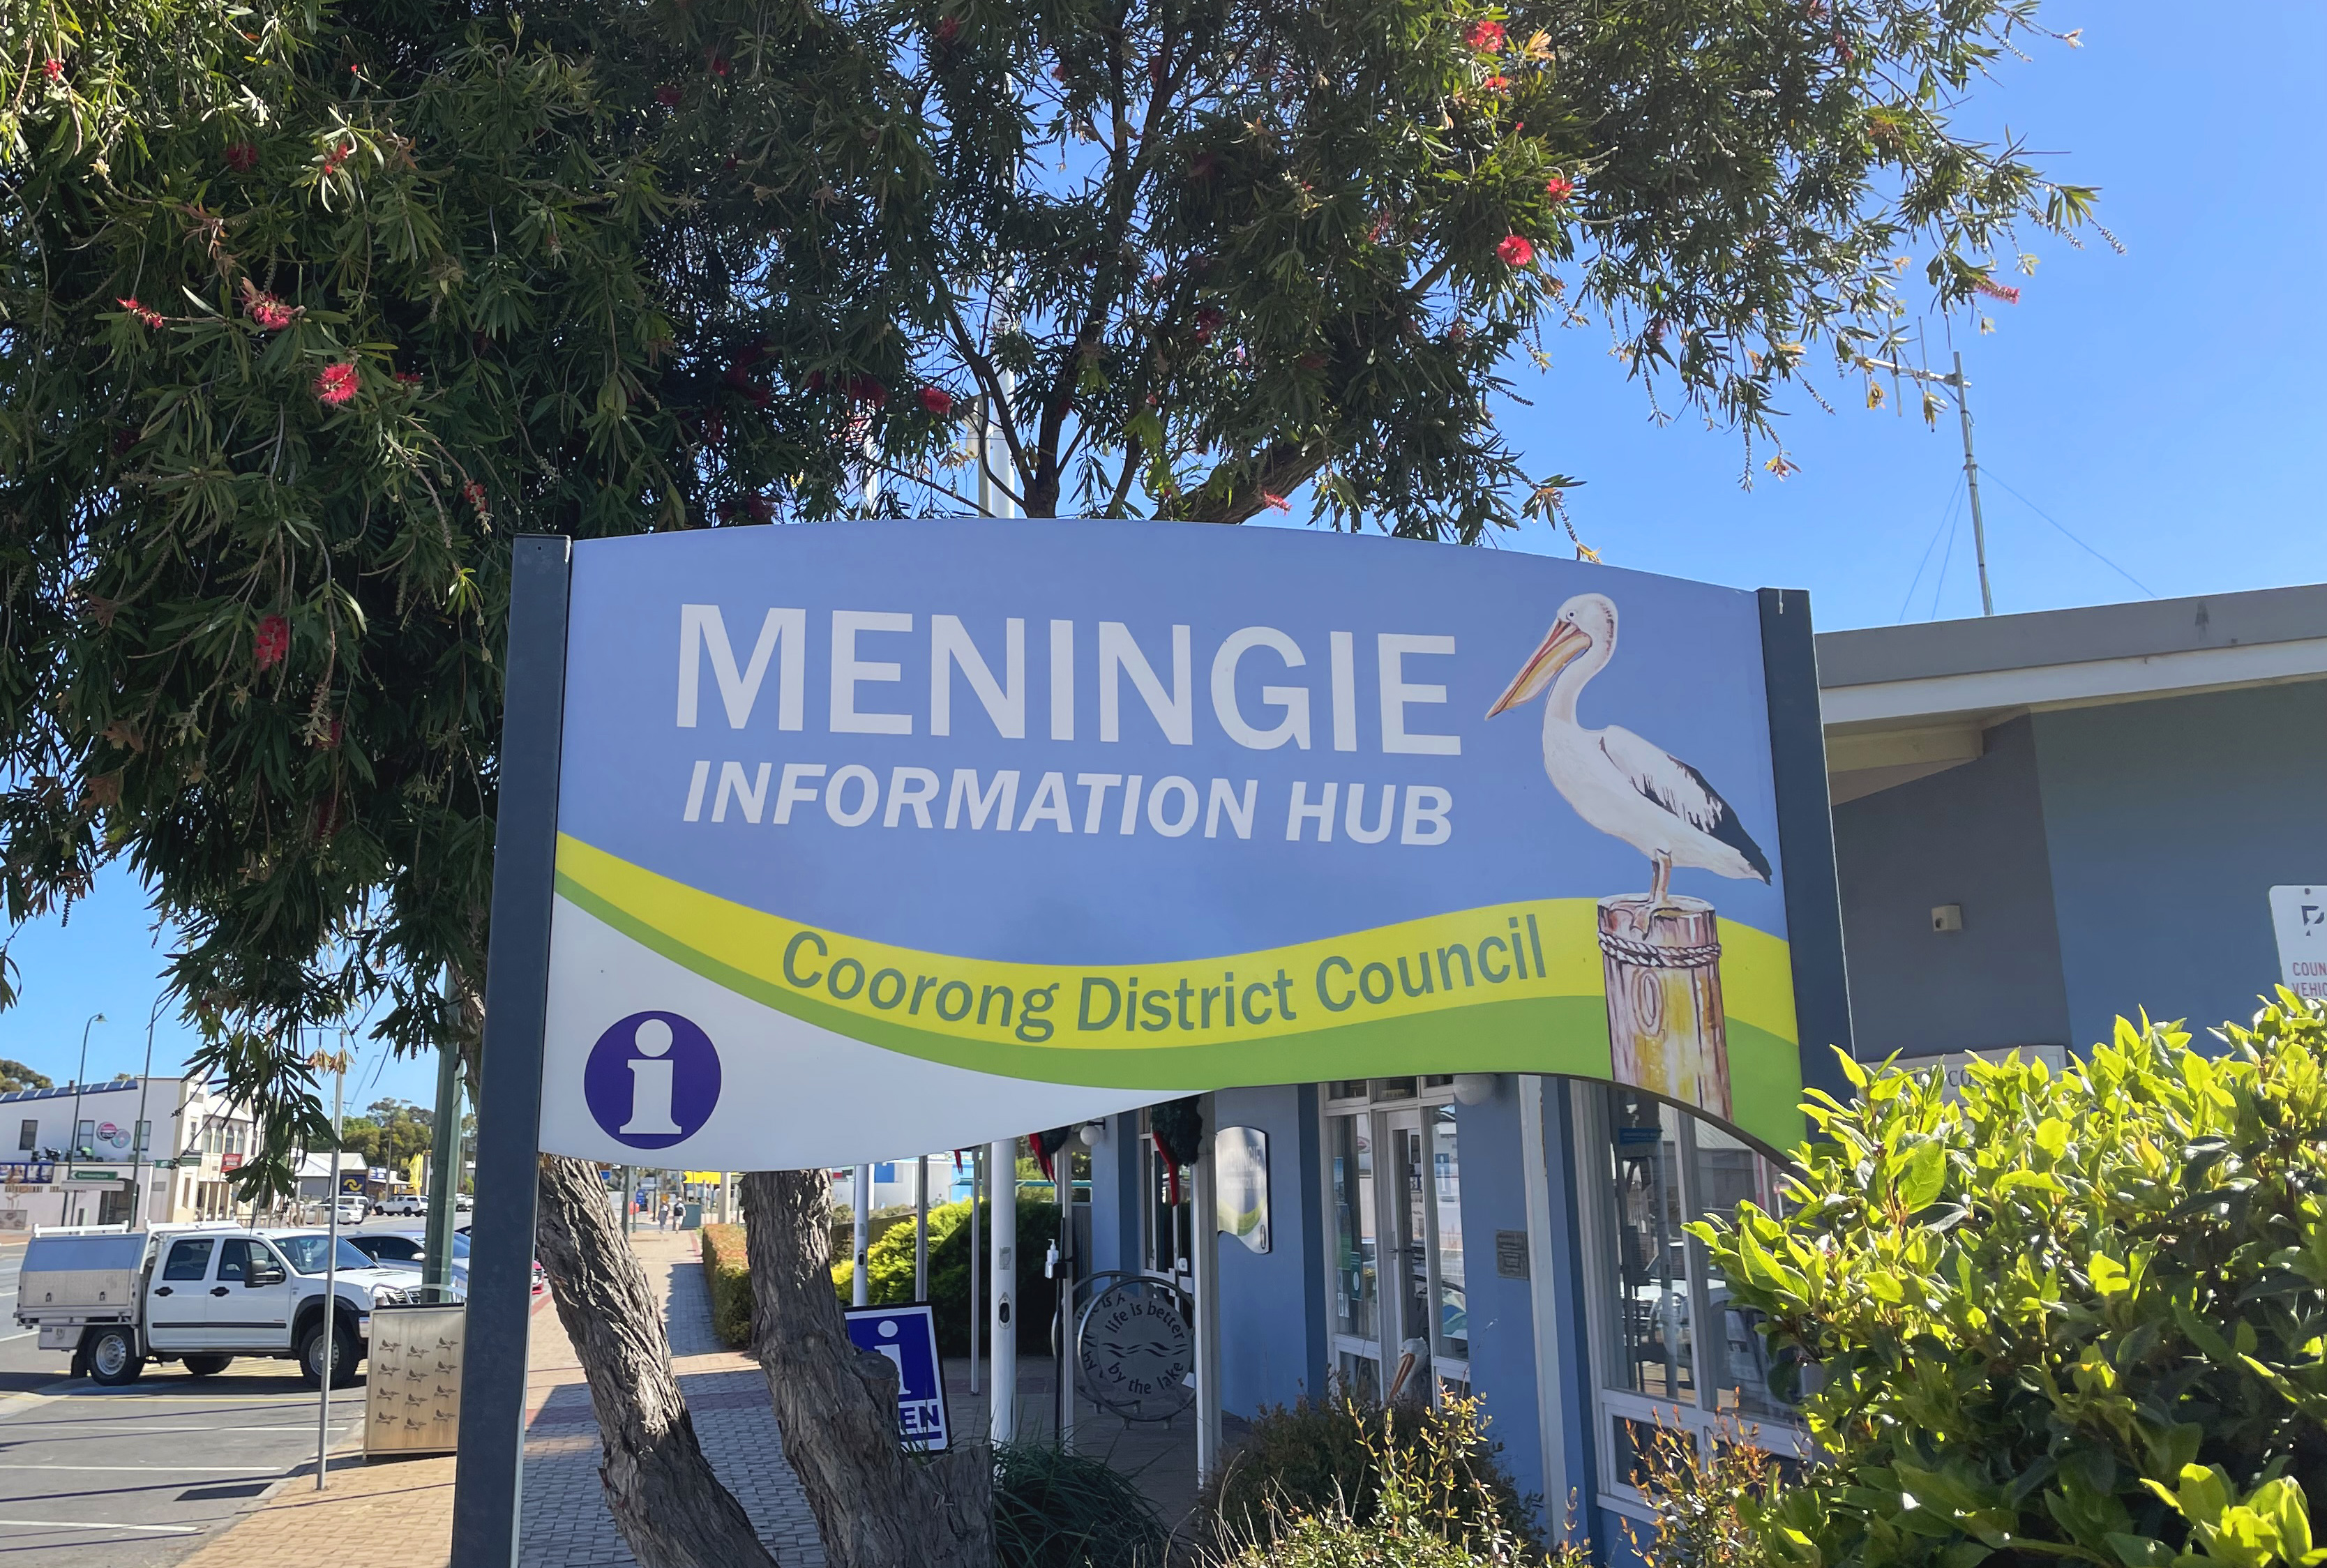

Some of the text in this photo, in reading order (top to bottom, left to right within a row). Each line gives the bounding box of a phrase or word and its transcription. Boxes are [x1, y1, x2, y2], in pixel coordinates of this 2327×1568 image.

[677, 604, 1461, 755] MENINGIE
[684, 760, 1453, 845] INFORMATION HUB
[783, 914, 1546, 1043] Coorong District Council
[1105, 1310, 1129, 1333] life
[1131, 1302, 1143, 1317] is
[1147, 1301, 1185, 1339] better
[1108, 1362, 1184, 1394] by the lake
